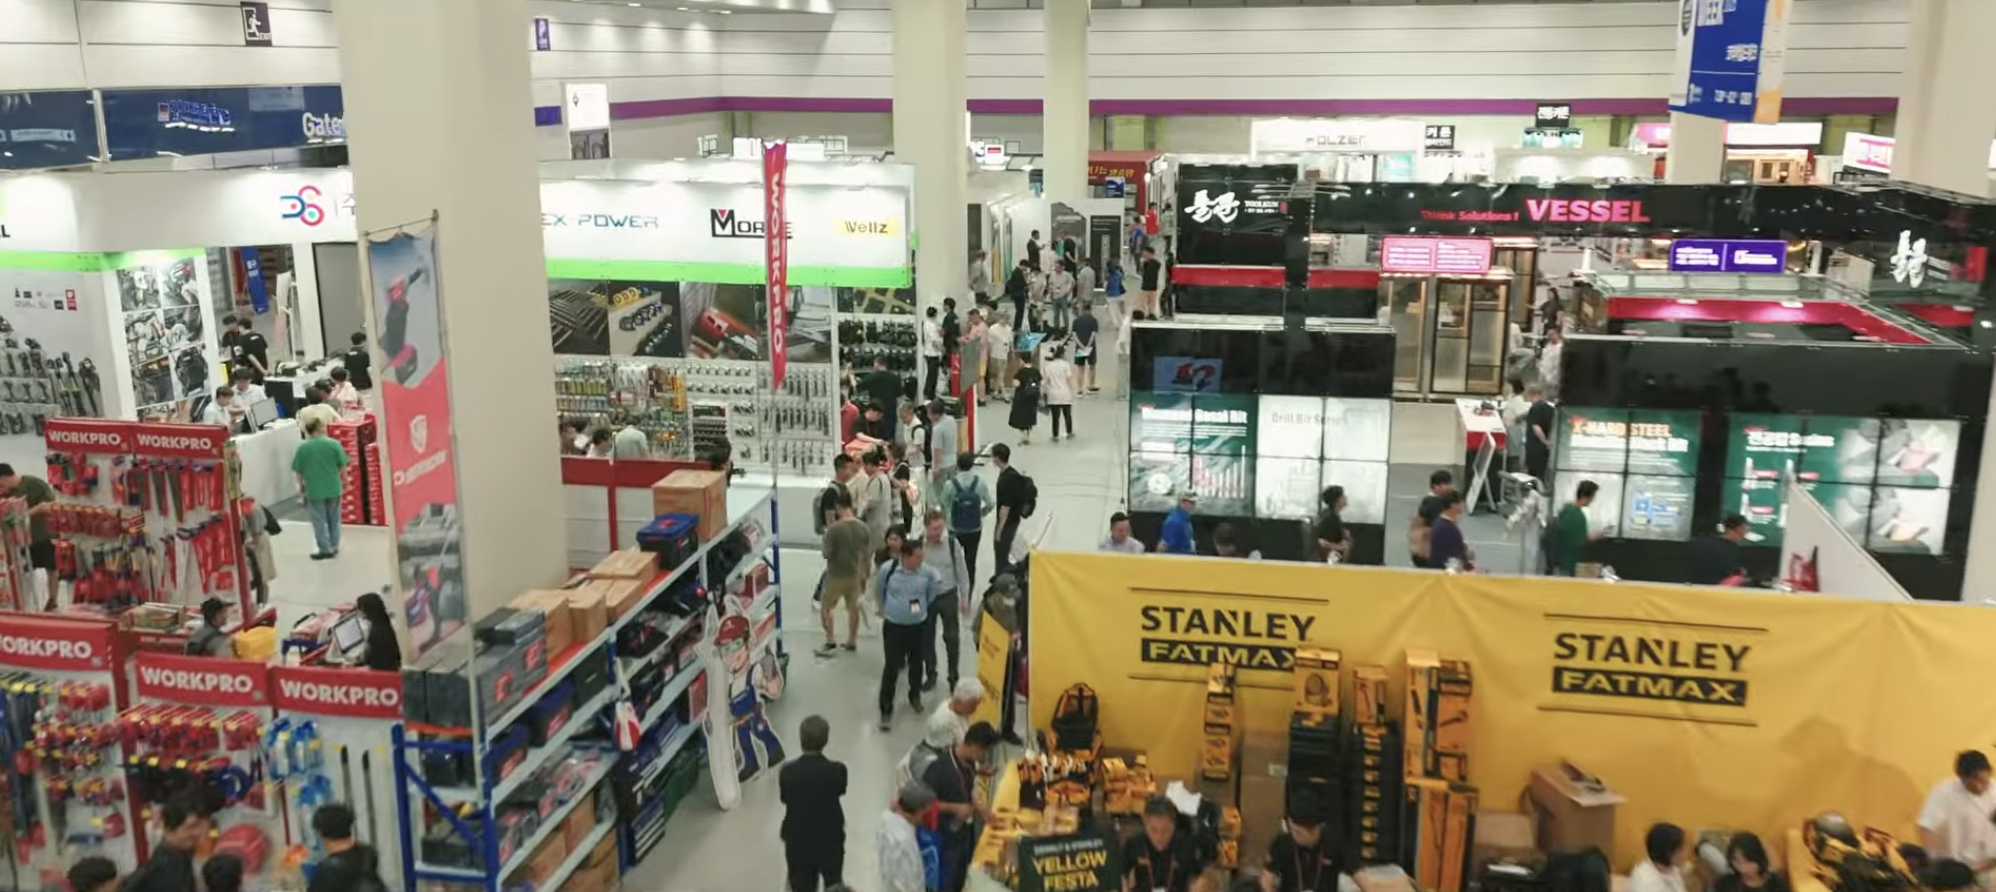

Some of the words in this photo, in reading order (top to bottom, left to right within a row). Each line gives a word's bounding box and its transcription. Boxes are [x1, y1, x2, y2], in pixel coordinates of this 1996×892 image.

[578, 214, 659, 228] POWER
[1525, 199, 1651, 222] VESSEL
[771, 172, 784, 354] WORKPRO
[50, 431, 121, 446] WORKPRO
[137, 434, 212, 449] WORKPRO
[1630, 423, 1672, 437] STEEL
[1141, 605, 1316, 641] STANLEY
[0, 634, 92, 659] ORKPRO
[1554, 633, 1750, 672] STANLEY
[140, 666, 253, 694] WORKPRO
[1561, 671, 1737, 702] FATMAX
[280, 679, 399, 707] WORKPRO
[1032, 850, 1107, 875] YELLOW
[1044, 870, 1099, 891] FESTA
